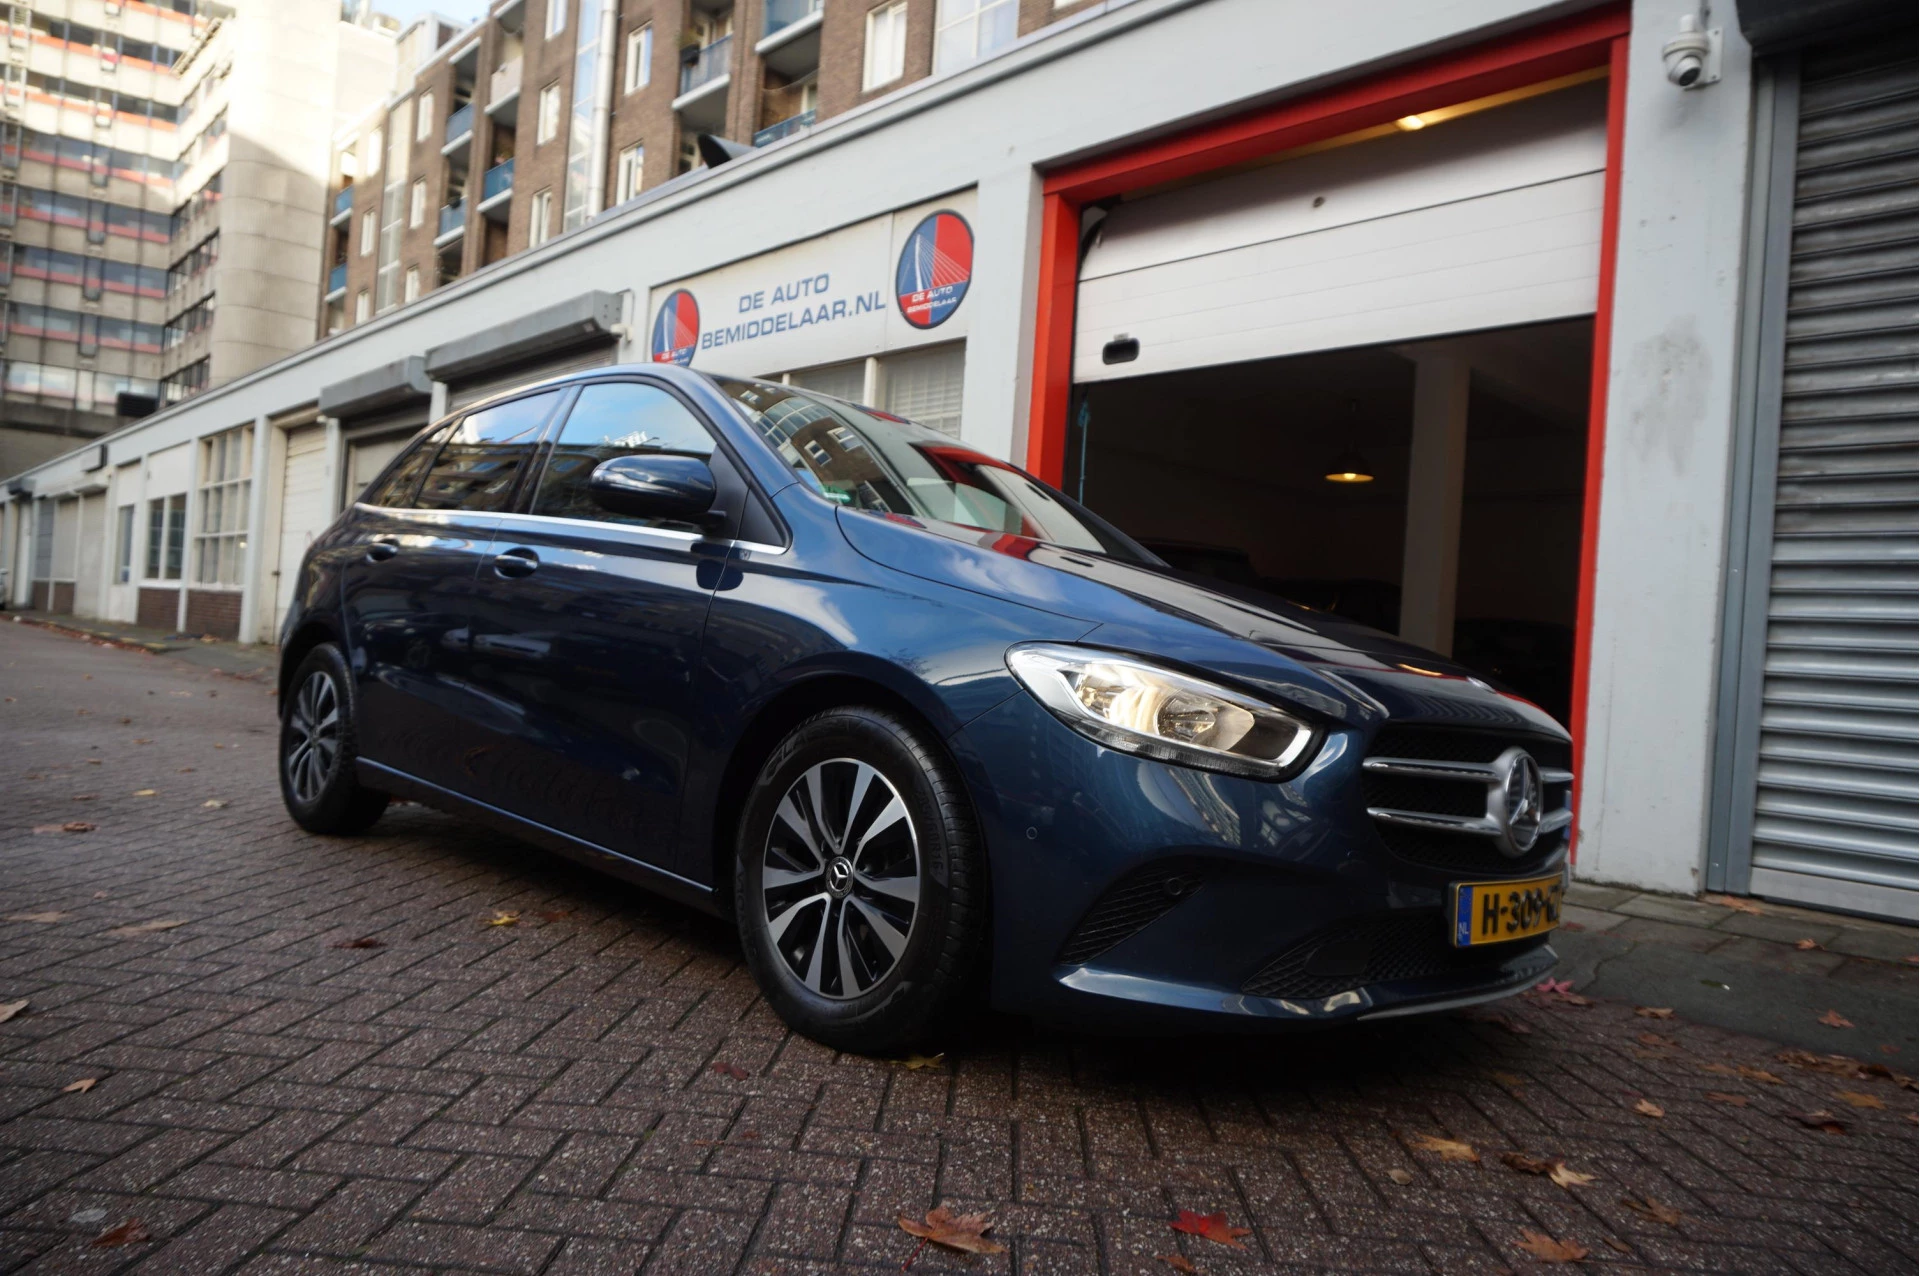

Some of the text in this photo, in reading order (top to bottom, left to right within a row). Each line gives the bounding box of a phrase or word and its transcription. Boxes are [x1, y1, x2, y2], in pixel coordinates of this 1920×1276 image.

[738, 273, 831, 314] DE AUTO
[911, 286, 953, 303] DE AUTO
[701, 290, 886, 350] BEMIDDELAAR.NL
[1459, 922, 1469, 935] NL
